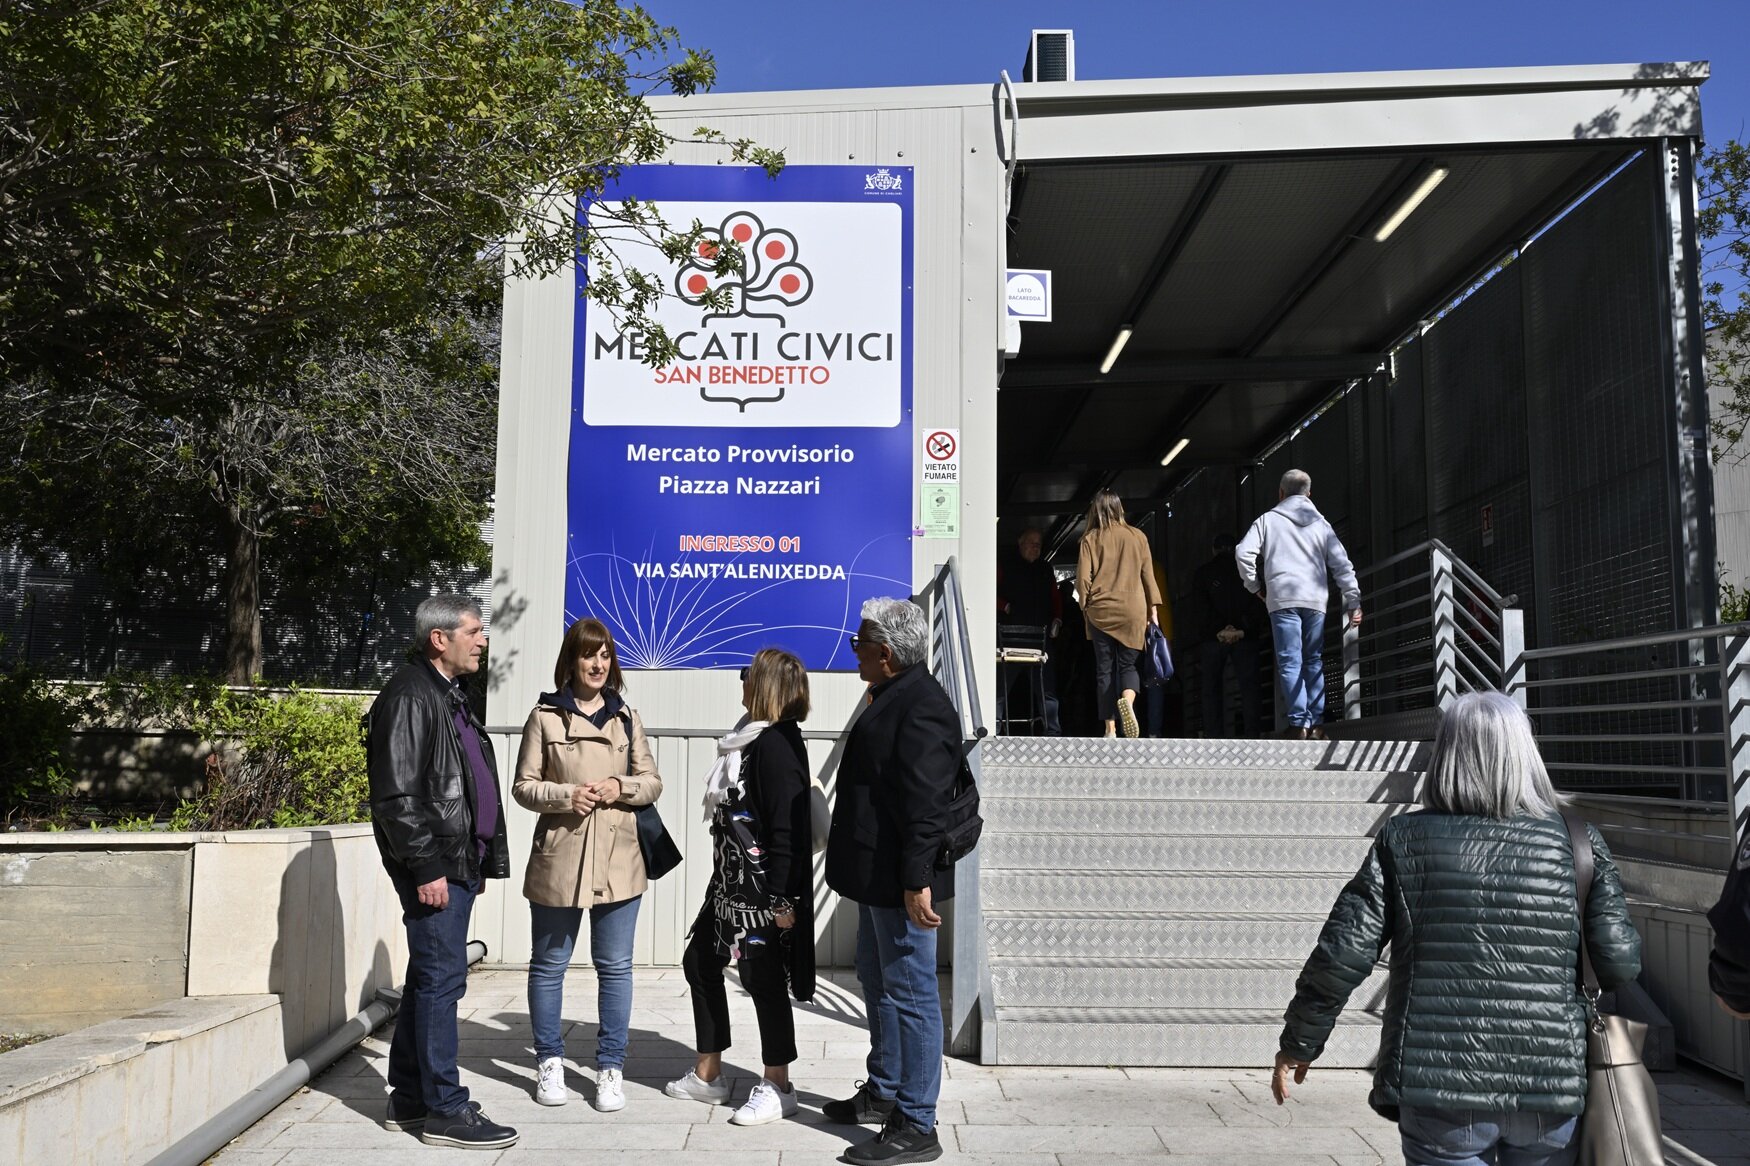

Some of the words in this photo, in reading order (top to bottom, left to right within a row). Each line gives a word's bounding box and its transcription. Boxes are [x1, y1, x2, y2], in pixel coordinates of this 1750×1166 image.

[594, 332, 758, 361] MECATI
[776, 332, 893, 362] CIVICI
[654, 365, 702, 385] SAN
[708, 365, 831, 385] BENEDETTO
[627, 444, 721, 463] Mercato
[727, 444, 855, 463] Provvisorio
[924, 463, 957, 471] VIETATO
[924, 472, 957, 480] FUMARE
[659, 475, 729, 495] Piazza
[736, 476, 820, 495] Nazzari
[679, 534, 776, 553] INGRESSO
[778, 535, 801, 553] 01
[632, 562, 666, 578] VIA
[669, 562, 846, 581] SANT'ALENIXEDDA
